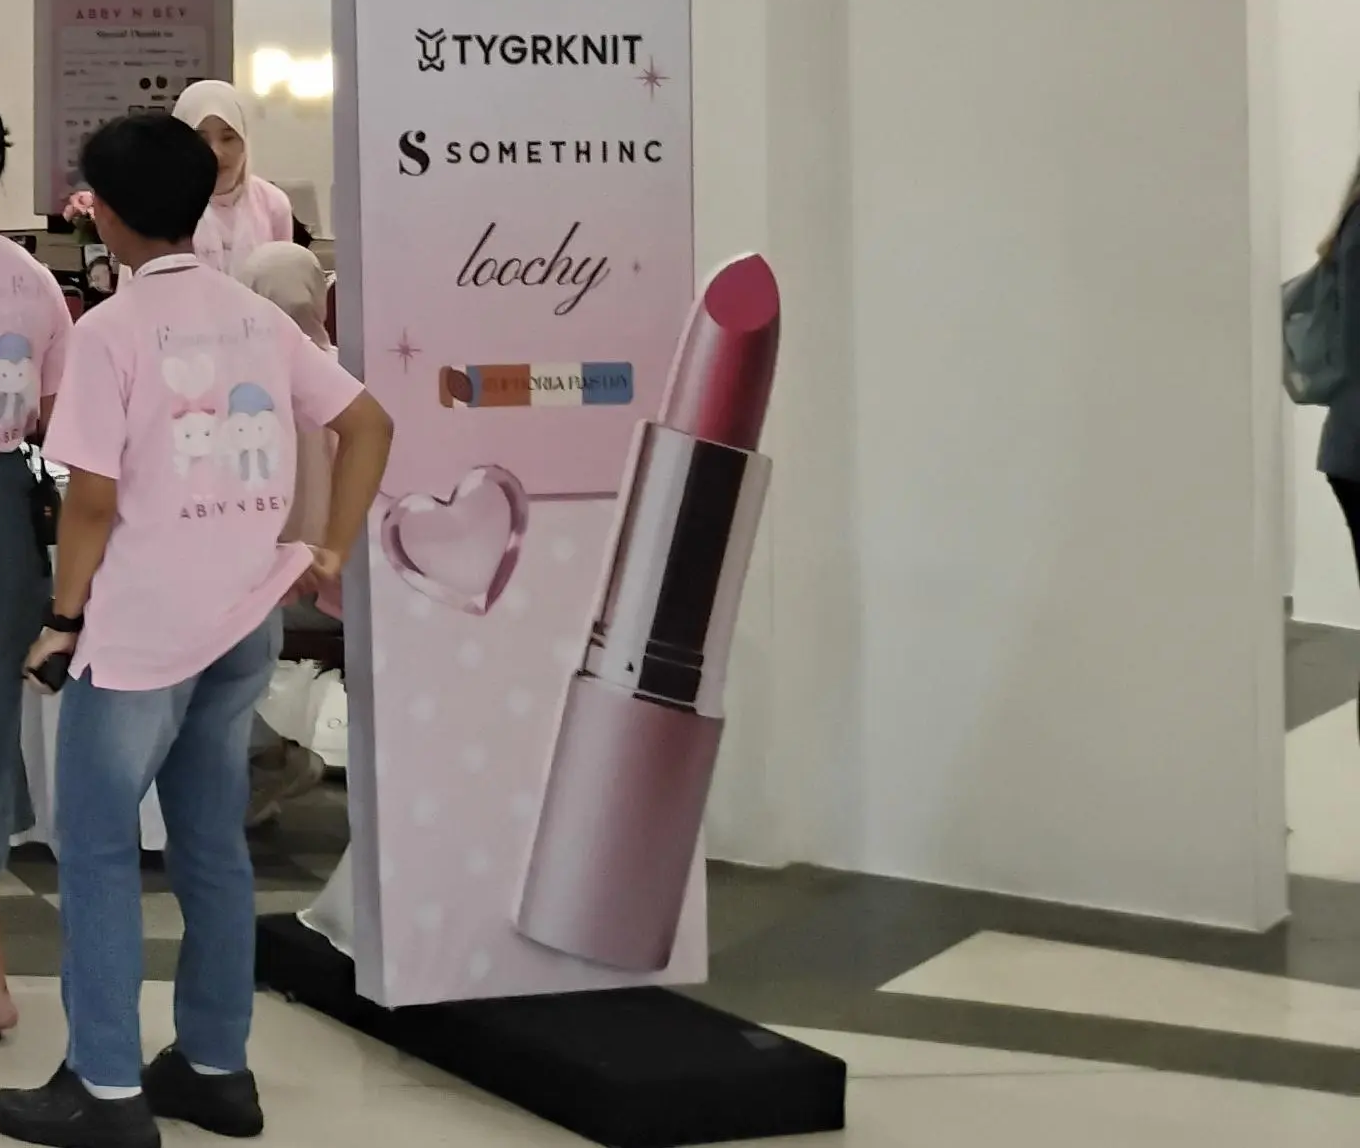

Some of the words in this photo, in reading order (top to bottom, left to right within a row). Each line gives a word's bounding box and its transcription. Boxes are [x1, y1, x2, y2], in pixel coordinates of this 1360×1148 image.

[452, 33, 642, 66] TYGRKNIT
[446, 139, 664, 164] SOMETHINC
[455, 221, 611, 316] loochy
